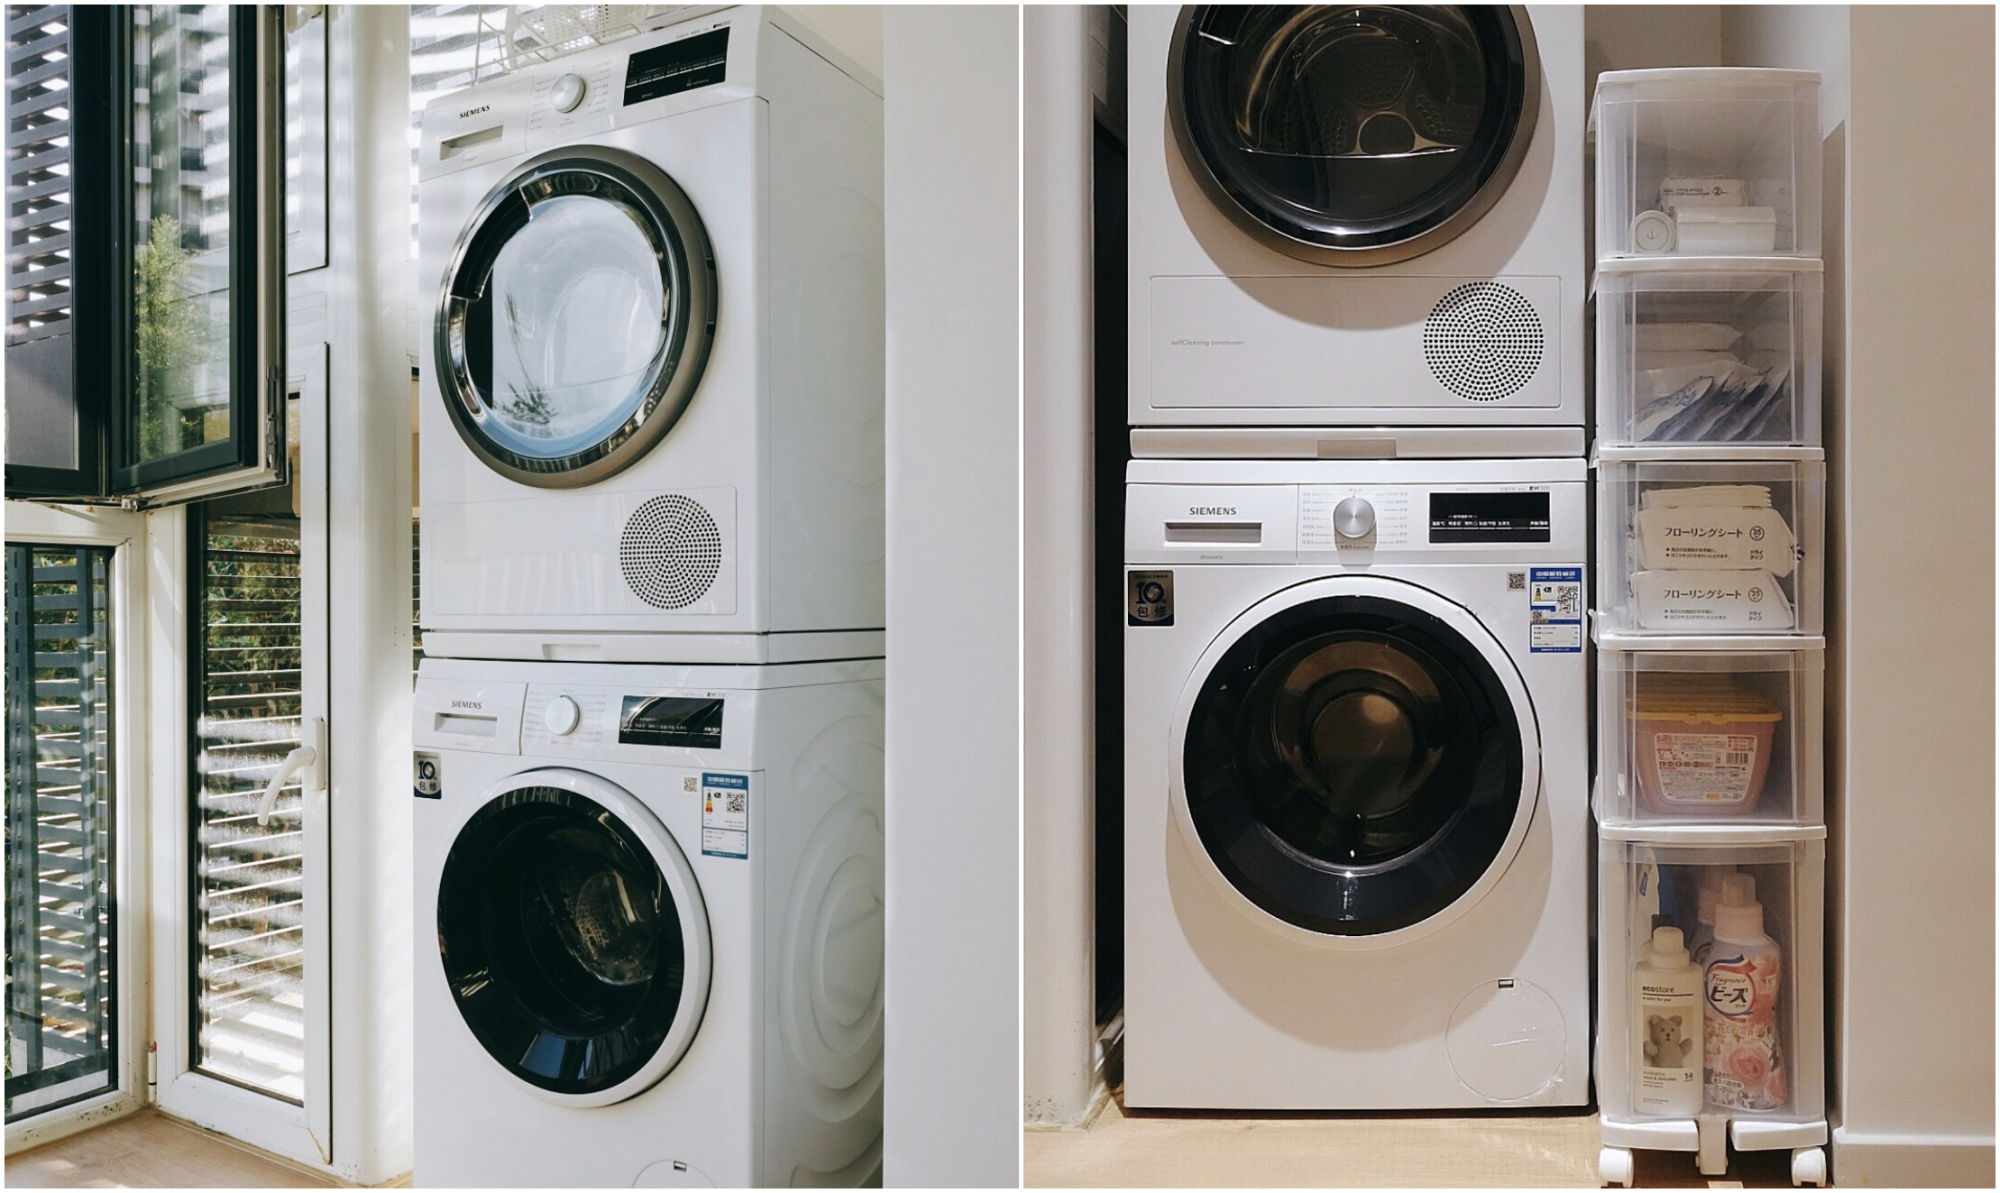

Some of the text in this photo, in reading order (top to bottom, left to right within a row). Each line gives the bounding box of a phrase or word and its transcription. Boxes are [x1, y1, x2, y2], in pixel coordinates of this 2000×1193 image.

[459, 104, 491, 119] SIEMENS
[1189, 507, 1237, 516] SIEMENS
[1665, 528, 1743, 538] フローリングシート
[1663, 590, 1742, 599] フローリングシート
[451, 700, 482, 710] SIEMENS
[418, 761, 436, 780] 10
[1710, 974, 1747, 985] Fragrance
[1642, 985, 1675, 993] ecostore
[1711, 986, 1749, 1004] ビーズ
